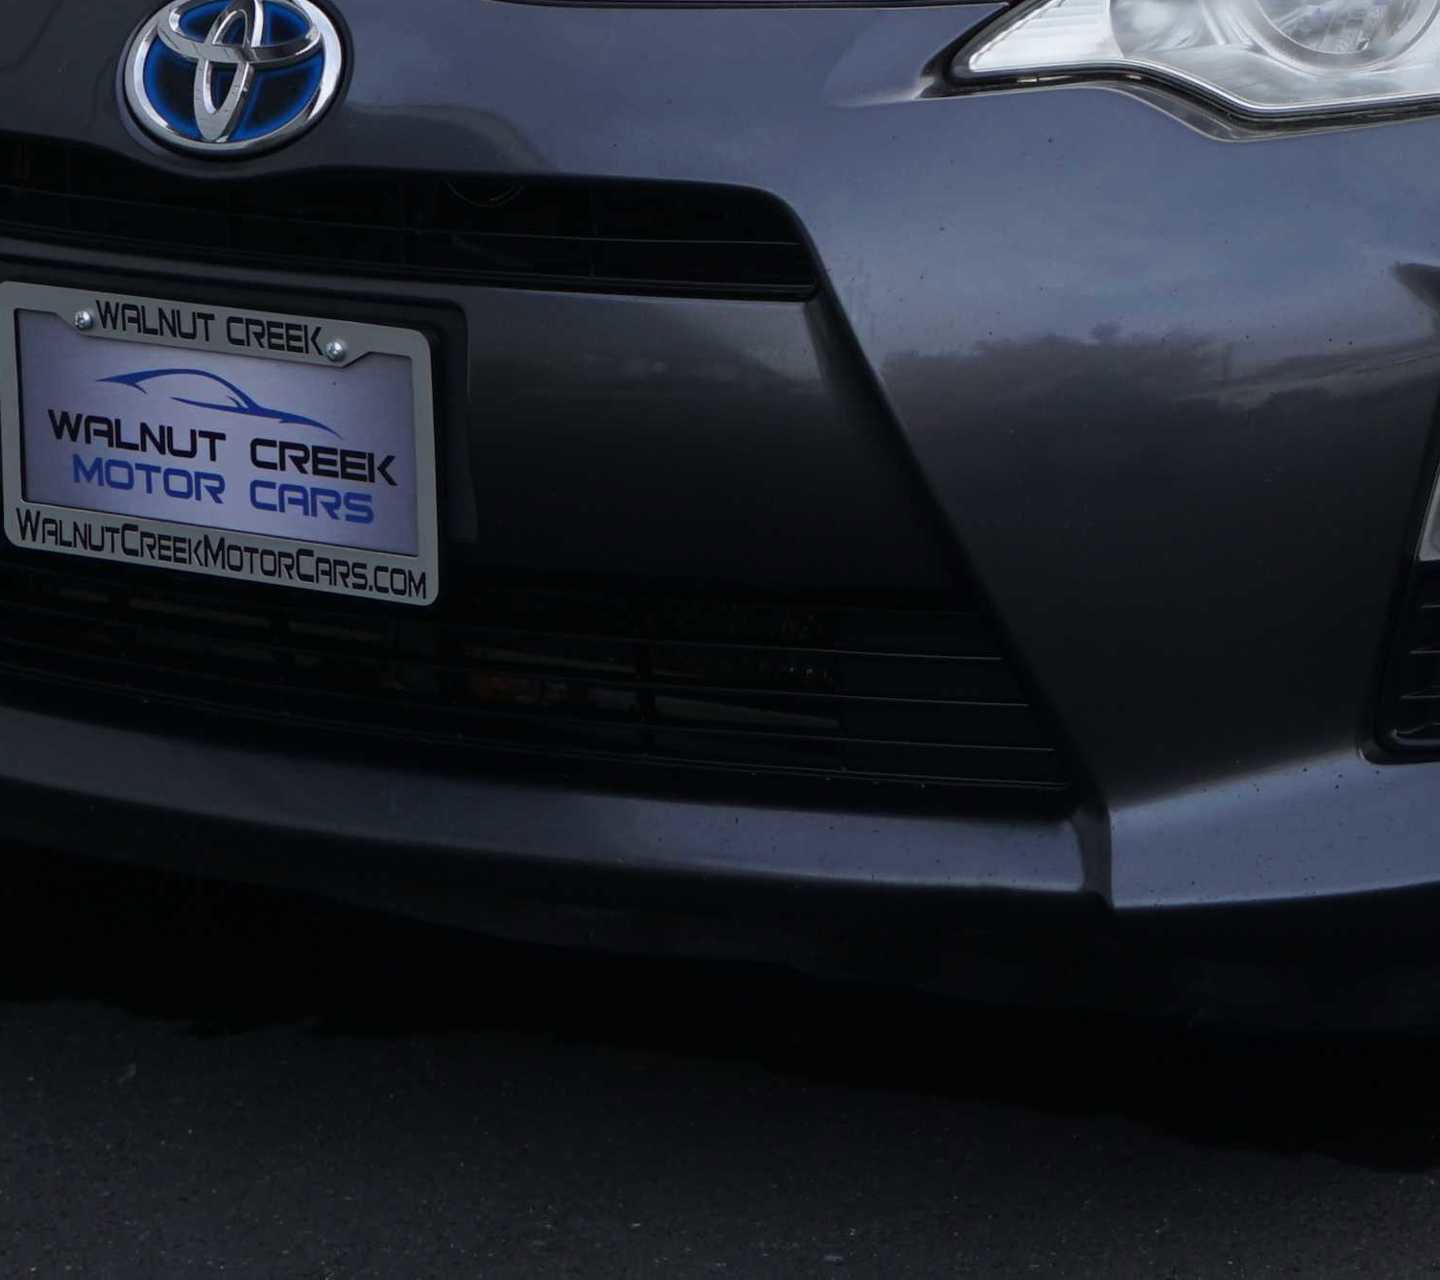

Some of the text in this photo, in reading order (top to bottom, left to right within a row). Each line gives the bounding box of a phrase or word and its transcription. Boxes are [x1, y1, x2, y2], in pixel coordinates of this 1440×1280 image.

[95, 299, 325, 356] WALNUT CREEK
[48, 408, 399, 487] WALNUT CREEK
[72, 453, 375, 524] MOTOR CARS
